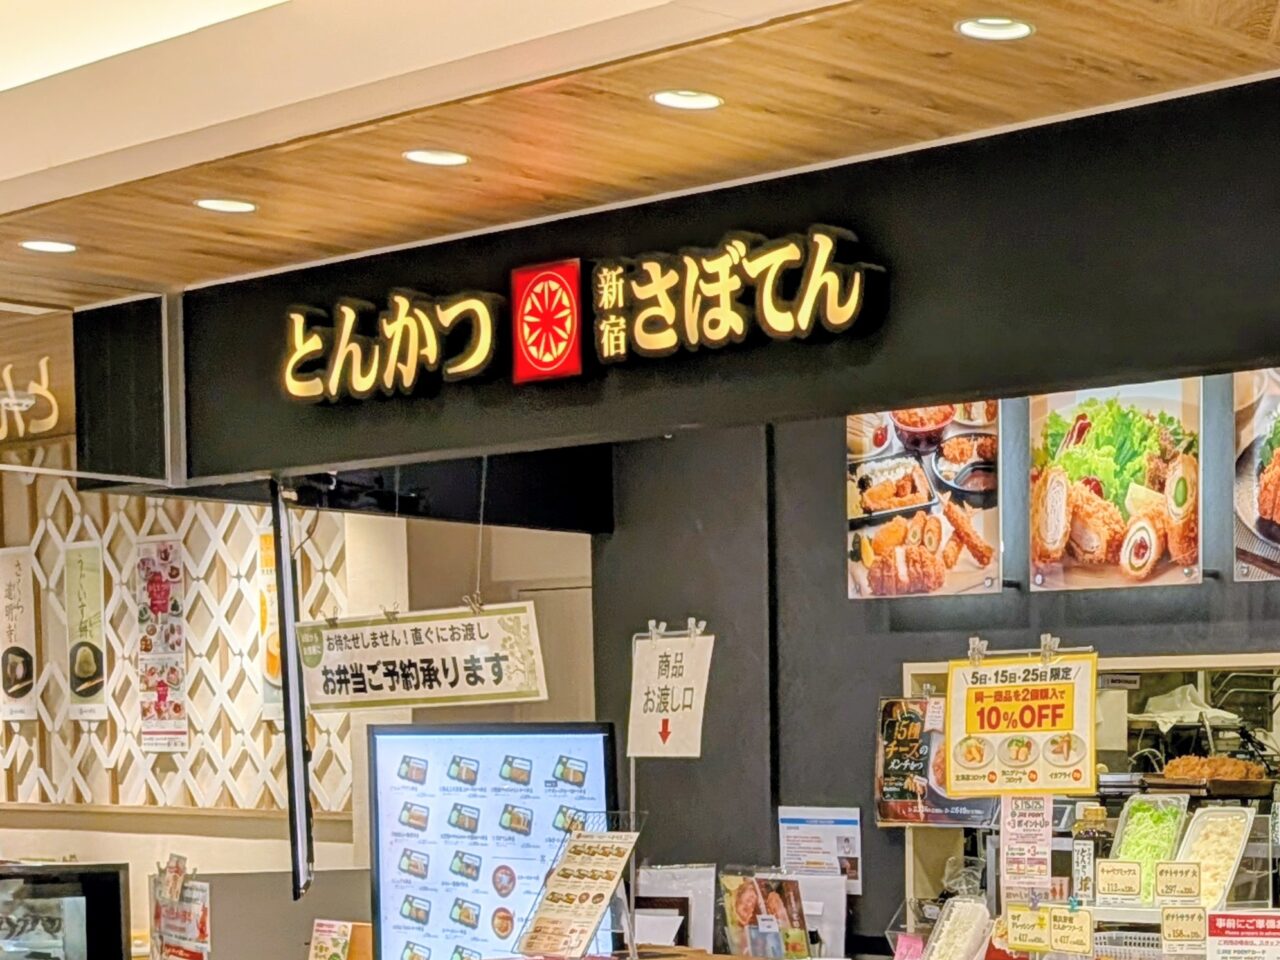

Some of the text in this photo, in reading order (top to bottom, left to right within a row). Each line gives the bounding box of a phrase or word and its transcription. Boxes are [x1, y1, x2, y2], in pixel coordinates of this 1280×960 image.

[630, 232, 864, 352] さぼてん
[597, 266, 627, 359] 新宿
[284, 295, 493, 398] とんかつ
[326, 621, 490, 652] お待たせしません！直ぐにお渡し
[321, 651, 510, 696] お弁当ご予約承ります
[657, 652, 685, 680] 商品
[642, 686, 695, 715] お渡し口
[977, 704, 1065, 731] 10%OFF
